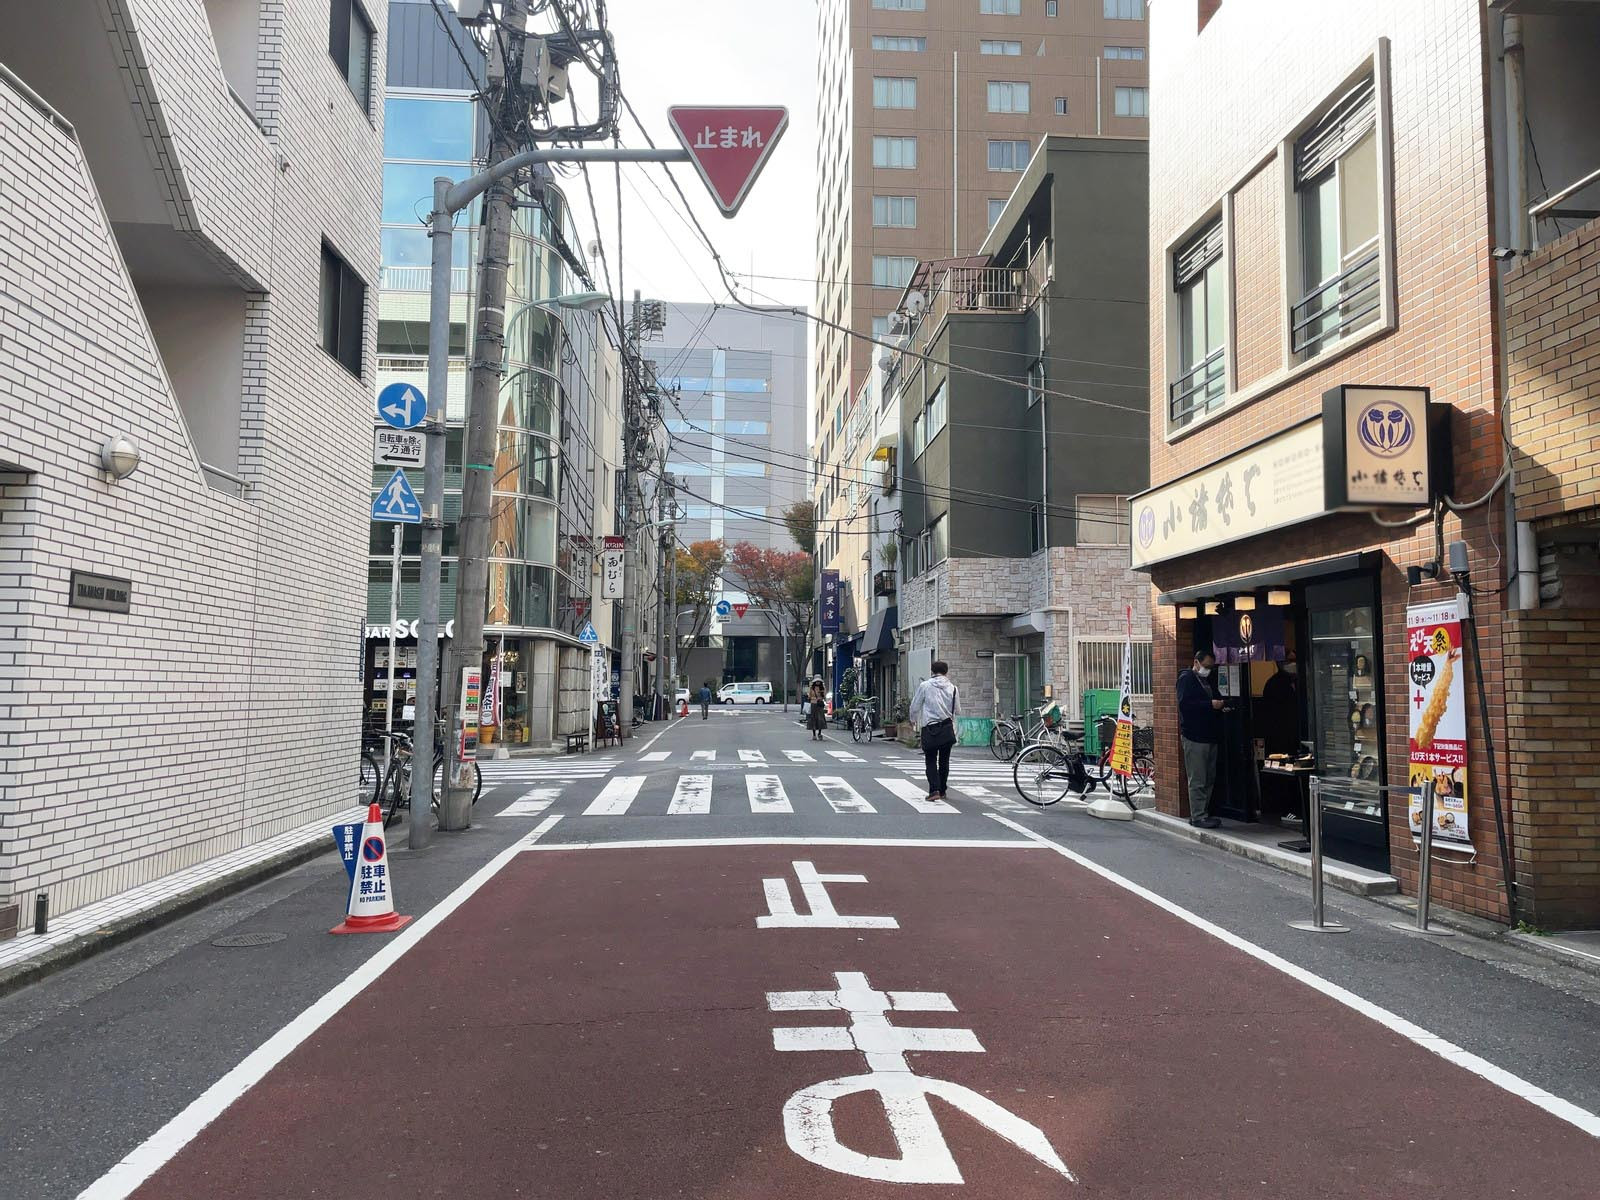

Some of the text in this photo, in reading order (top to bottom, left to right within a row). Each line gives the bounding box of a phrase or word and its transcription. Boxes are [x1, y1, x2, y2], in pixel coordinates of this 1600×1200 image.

[693, 126, 764, 149] 止まれ
[379, 433, 421, 445] 自転車を除く
[378, 444, 421, 456] 一方通行
[1414, 673, 1431, 682] サービス
[344, 826, 353, 860] 駐車禁止
[361, 865, 385, 879] 駐車
[360, 880, 385, 894] 禁止
